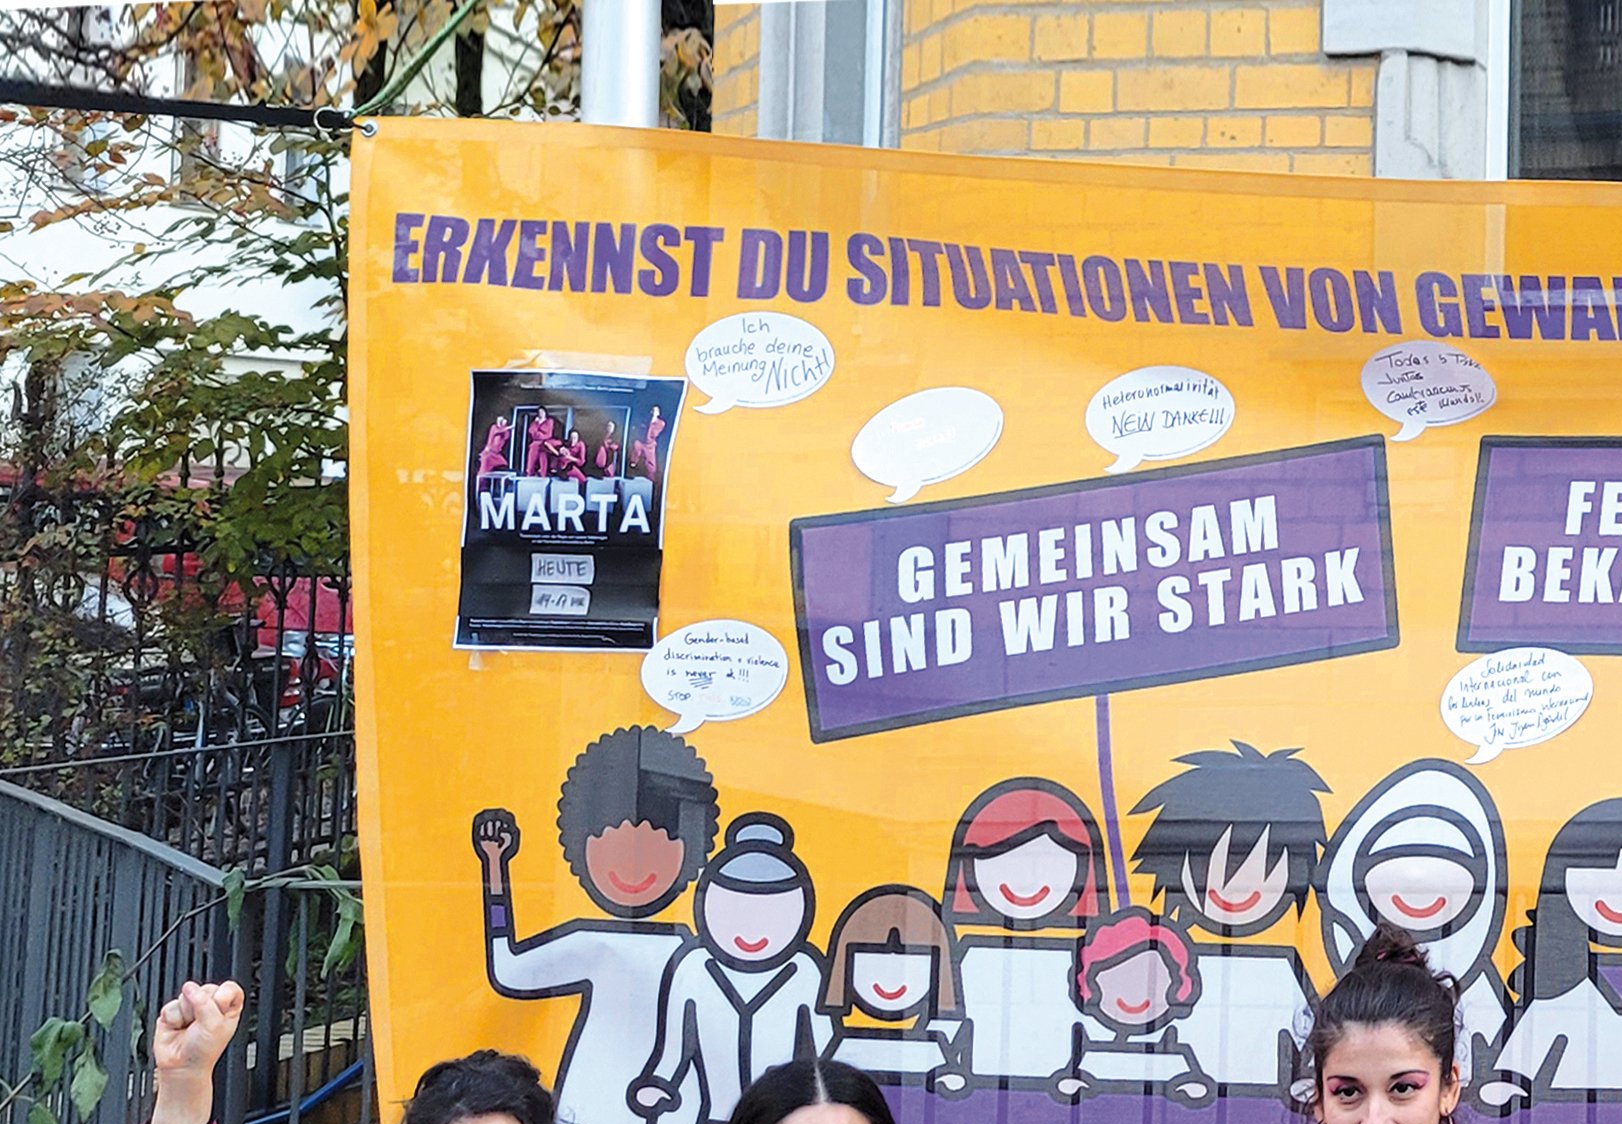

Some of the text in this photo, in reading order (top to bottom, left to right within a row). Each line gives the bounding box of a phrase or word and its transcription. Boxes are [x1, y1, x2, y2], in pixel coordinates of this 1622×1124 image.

[392, 212, 724, 297] ERKENNST
[737, 228, 828, 304] DU
[846, 232, 1253, 327] SITUATIONEN
[1258, 266, 1402, 335] VON
[741, 318, 770, 333] Ich
[695, 337, 814, 362] brauche deine
[702, 359, 767, 382] Meinung
[480, 491, 651, 533] MARTA
[897, 495, 1280, 603] GEMEINSAM
[536, 559, 588, 576] HEUTE
[822, 547, 1365, 685] SIND WIR STARK
[664, 648, 732, 662] discrimination
